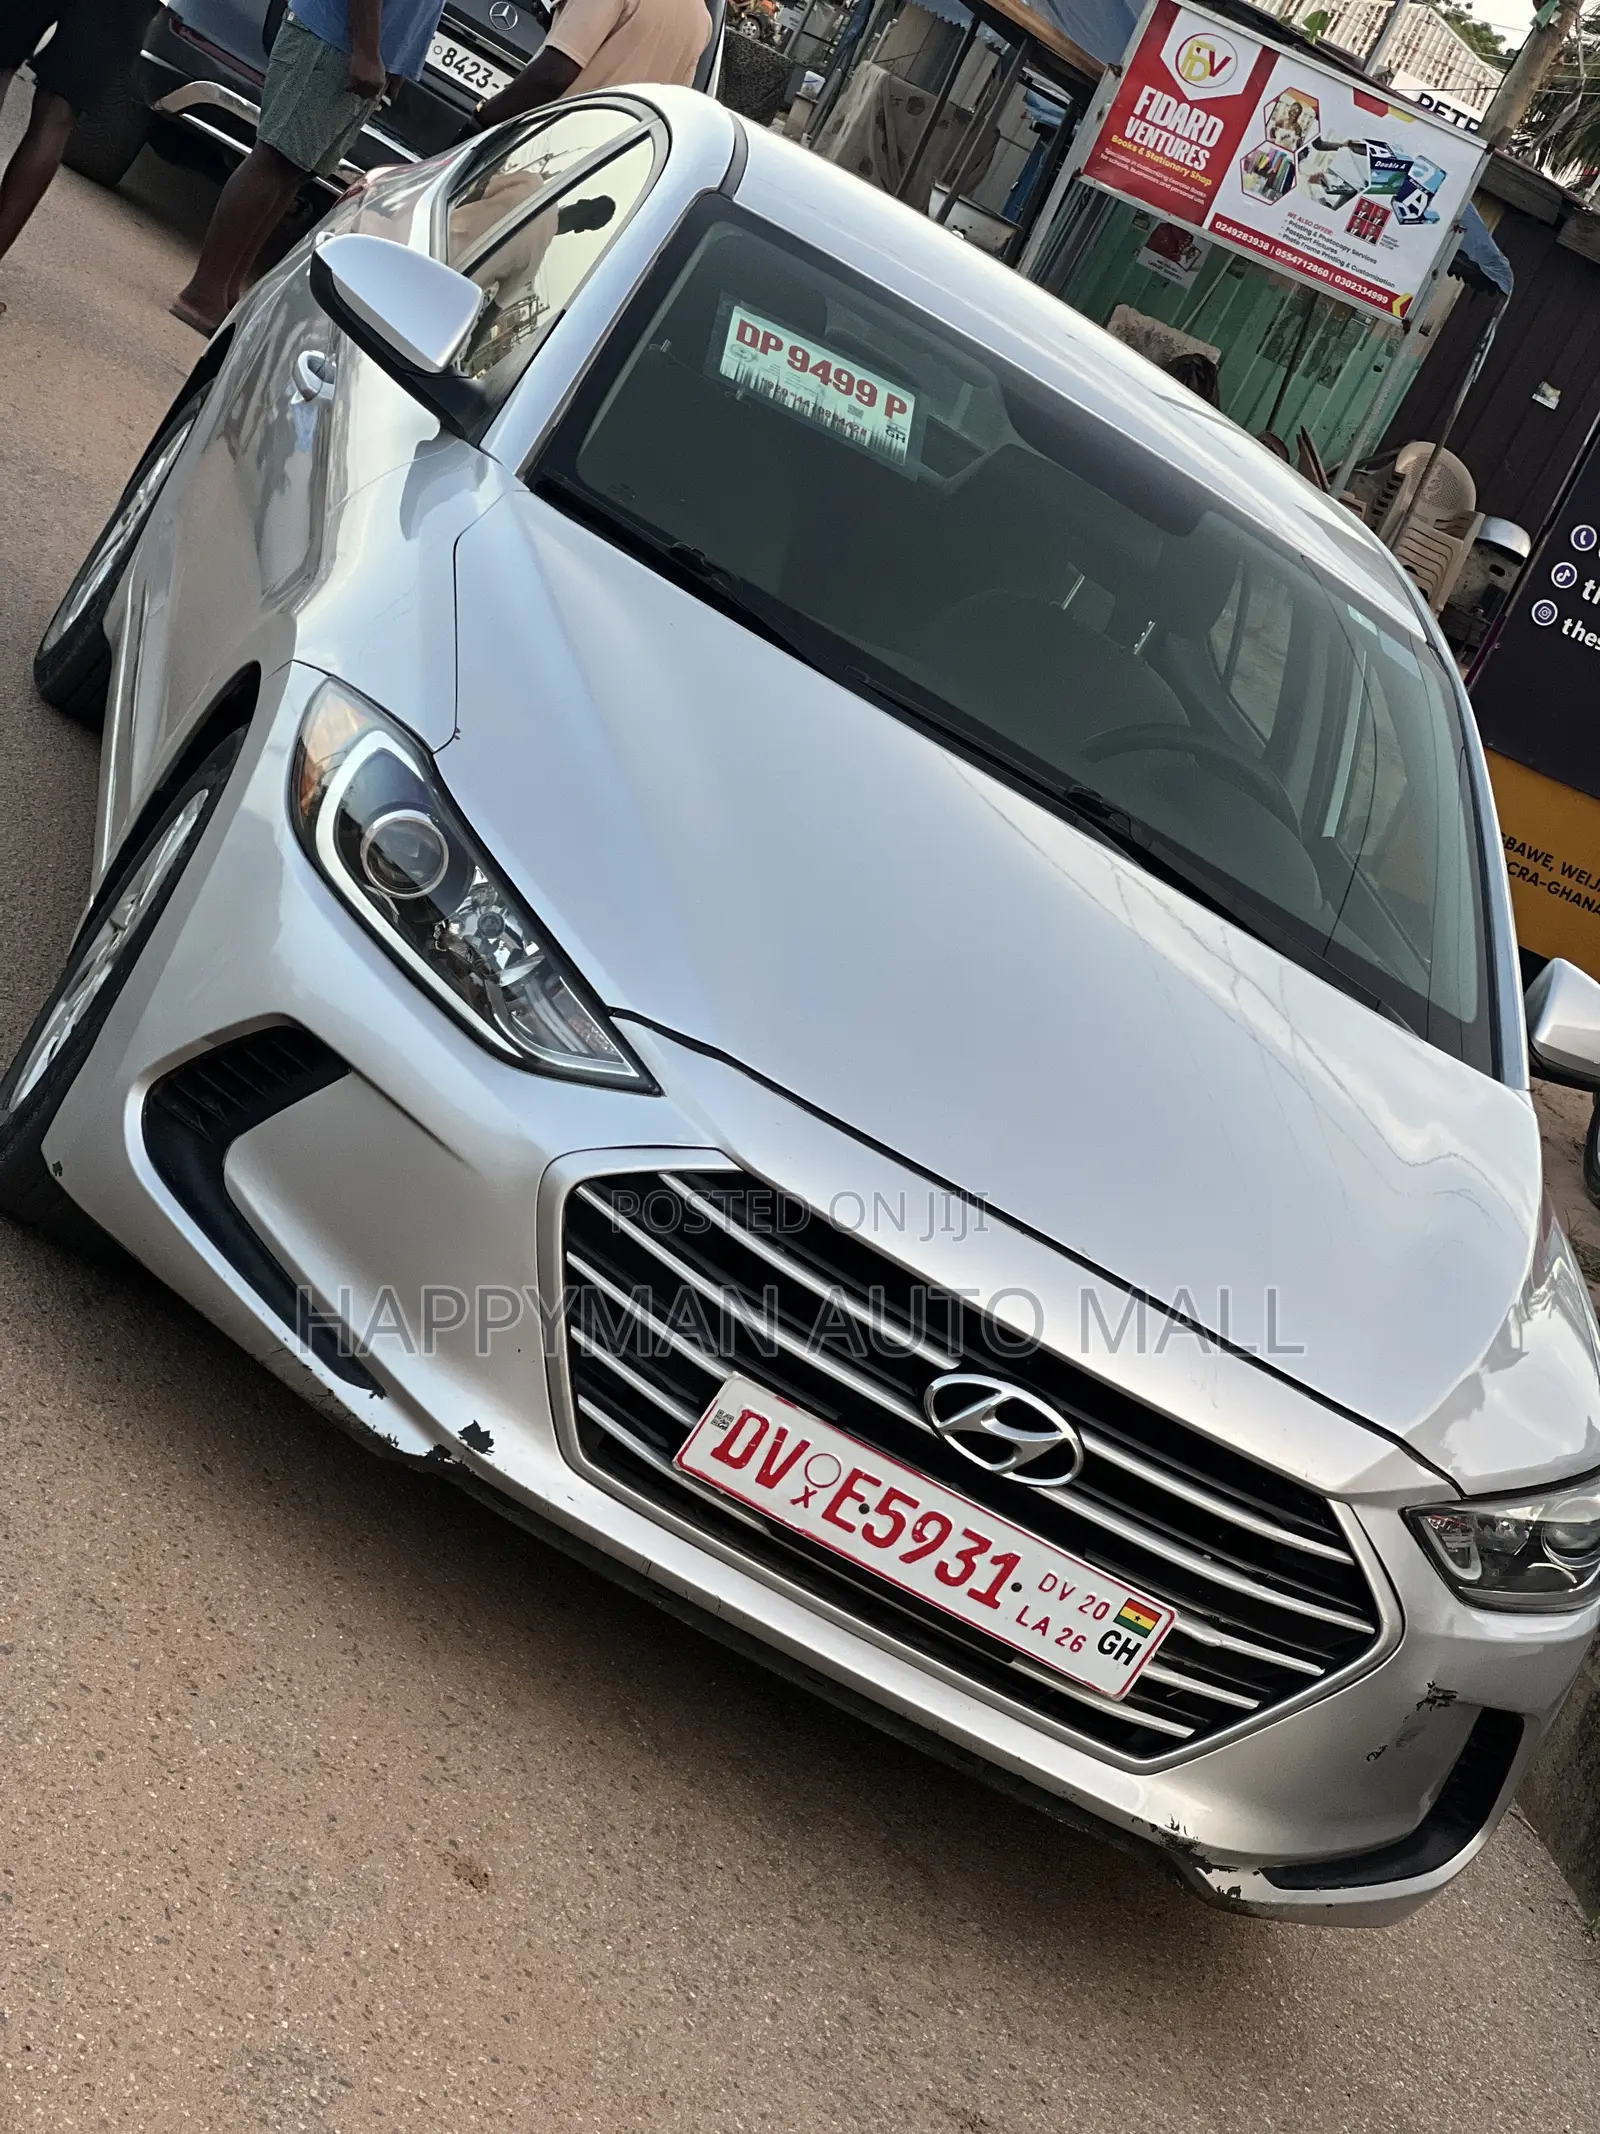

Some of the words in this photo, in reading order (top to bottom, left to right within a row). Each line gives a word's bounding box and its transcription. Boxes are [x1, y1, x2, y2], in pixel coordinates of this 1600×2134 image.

[441, 47, 512, 89] 8423-
[1133, 84, 1224, 147] FIDARD
[1111, 134, 1138, 152] Books
[1138, 147, 1145, 156] &
[1145, 150, 1190, 177] Stationery
[1190, 170, 1212, 187] Shop
[1124, 116, 1210, 171] VENTURES
[1375, 160, 1399, 169] Double
[1285, 227, 1312, 244] Passport
[1312, 239, 1338, 255] Pictures
[1287, 212, 1297, 221] WE
[1296, 217, 1313, 227] ALSO
[1313, 223, 1334, 236] OFFER:
[1288, 220, 1313, 236] Printing
[1319, 234, 1351, 253] Photocopy
[1351, 249, 1378, 265] Services
[1215, 221, 1270, 250] 0249283938
[1275, 248, 1329, 278] 0554712860
[1334, 275, 1389, 304] 0302334999
[1282, 233, 1300, 246] Photo
[1300, 242, 1321, 255] Frame
[1321, 251, 1346, 267] Printing
[1351, 264, 1395, 288] Customization
[736, 319, 784, 356] DP
[787, 345, 878, 408] 9499
[884, 392, 908, 419] P
[885, 428, 906, 444] GH
[1560, 861, 1600, 892] WEIJ
[710, 1408, 810, 1490] DV
[821, 1465, 1023, 1610] E5931
[1037, 1571, 1077, 1604] DV
[1077, 1593, 1112, 1622] 20
[1015, 1606, 1050, 1638] LA
[1053, 1626, 1088, 1653] 26
[1096, 1630, 1142, 1667] GH
